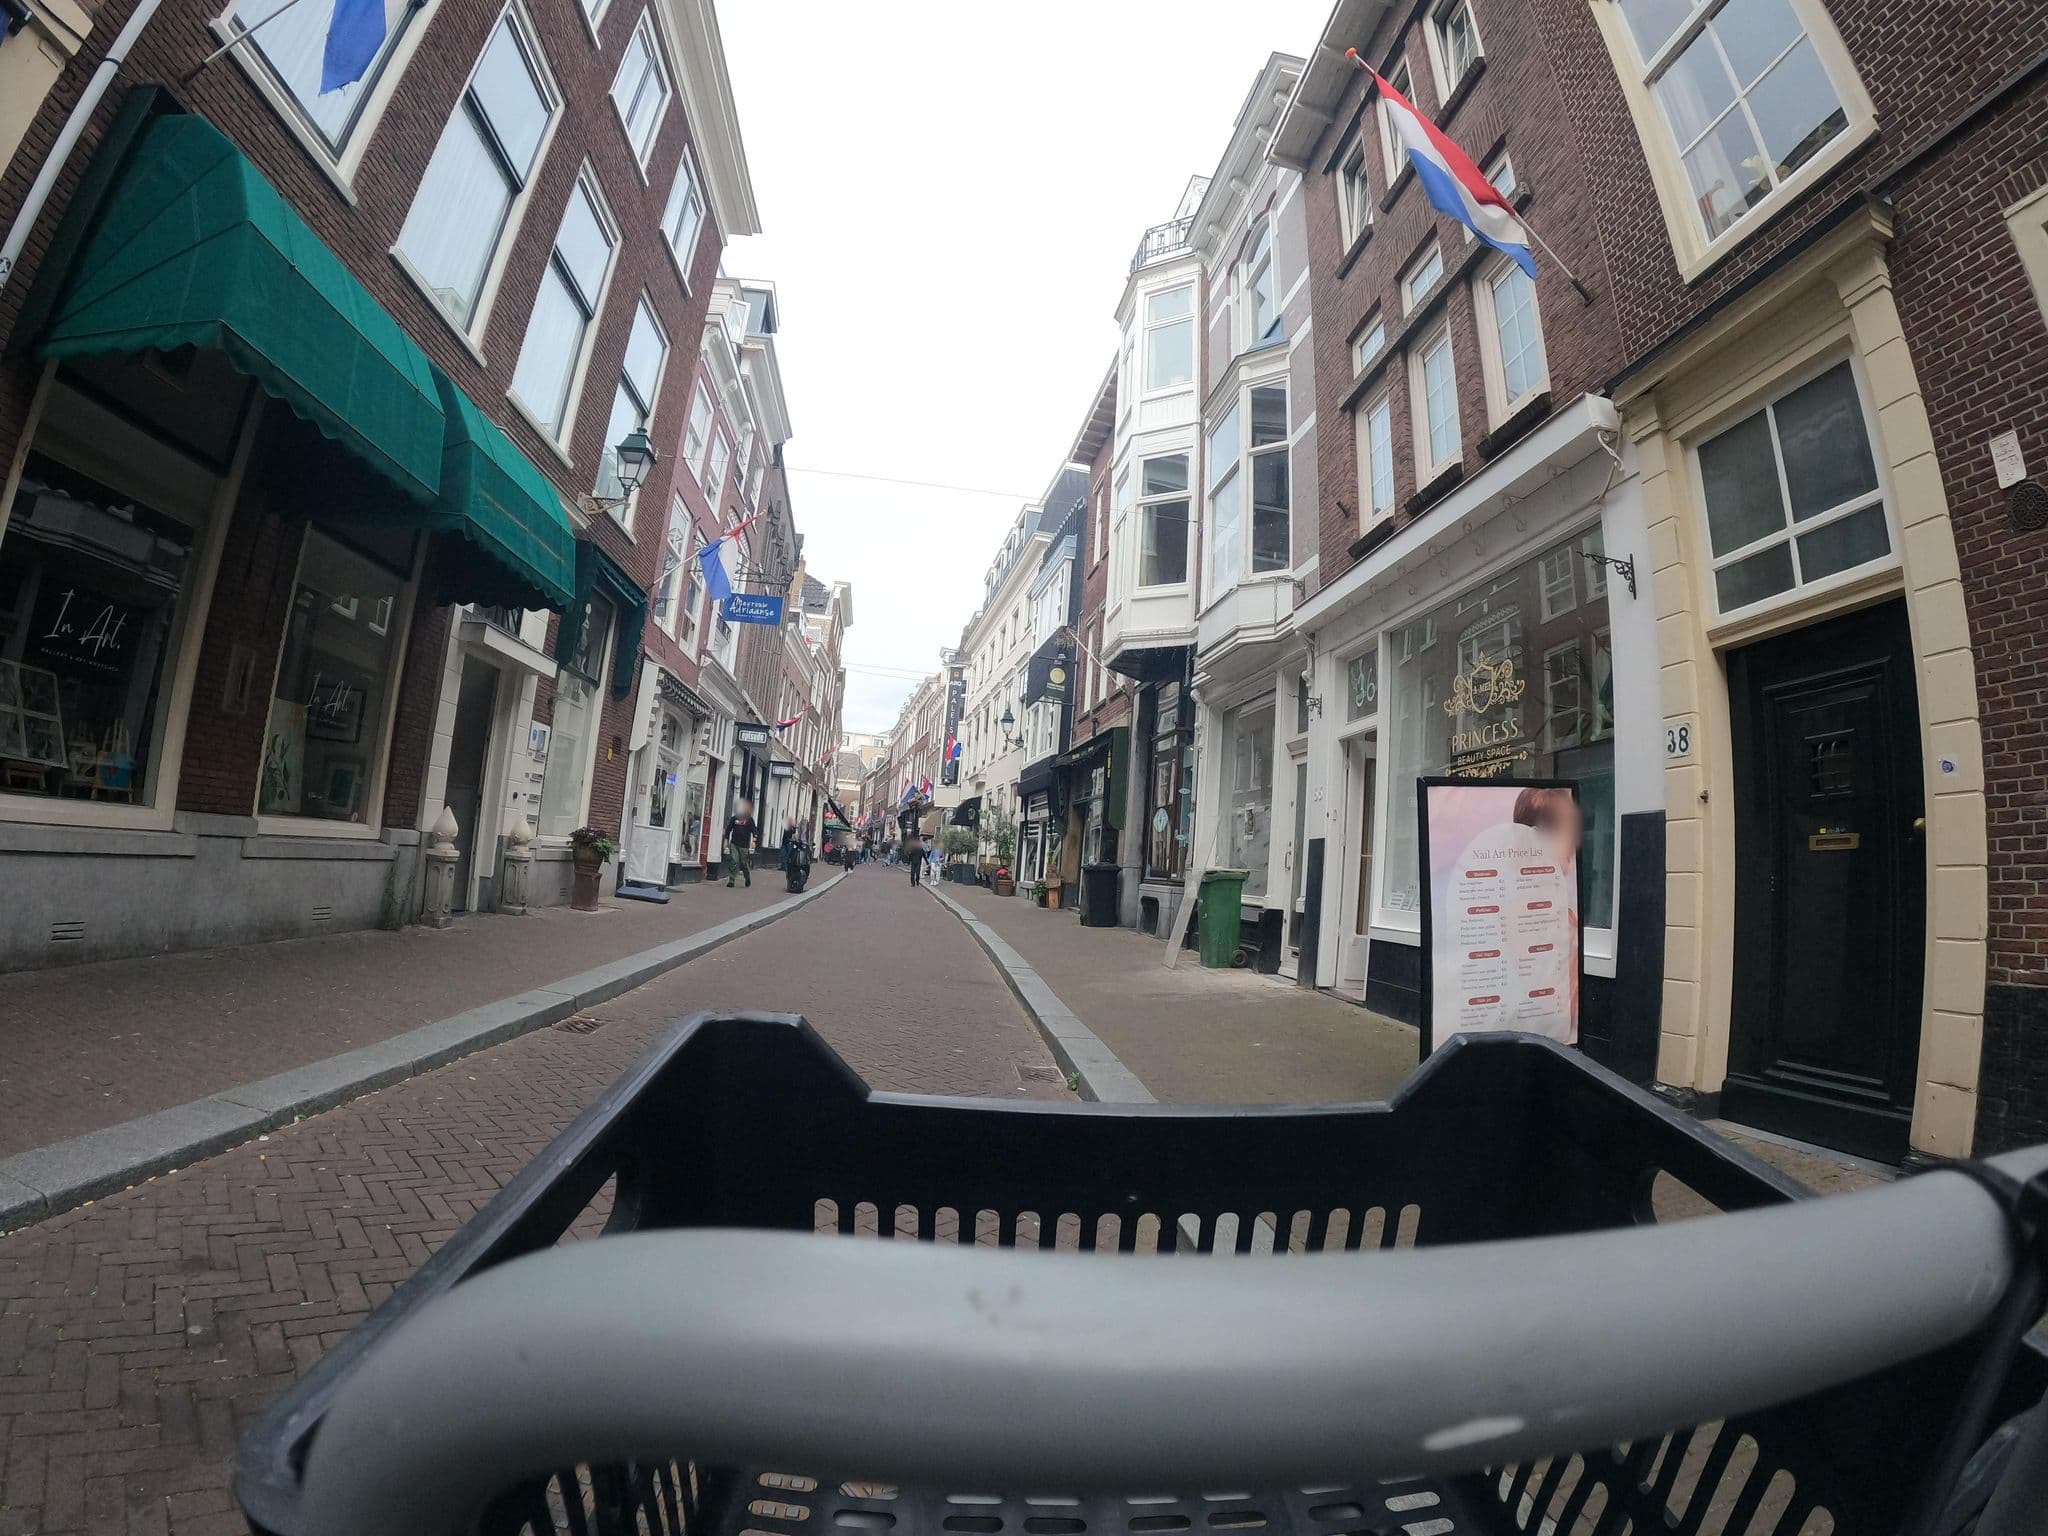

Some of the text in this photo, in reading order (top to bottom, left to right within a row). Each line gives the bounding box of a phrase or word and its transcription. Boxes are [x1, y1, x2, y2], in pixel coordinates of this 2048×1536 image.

[43, 589, 75, 638] In
[729, 600, 775, 617] Adriaanse
[948, 690, 958, 734] PALEIS
[1452, 717, 1519, 753] PRINCESS
[1667, 726, 1689, 753] 38
[1457, 745, 1512, 766] BEAUTY SPACE
[1472, 847, 1544, 860] Nail Art Price List
